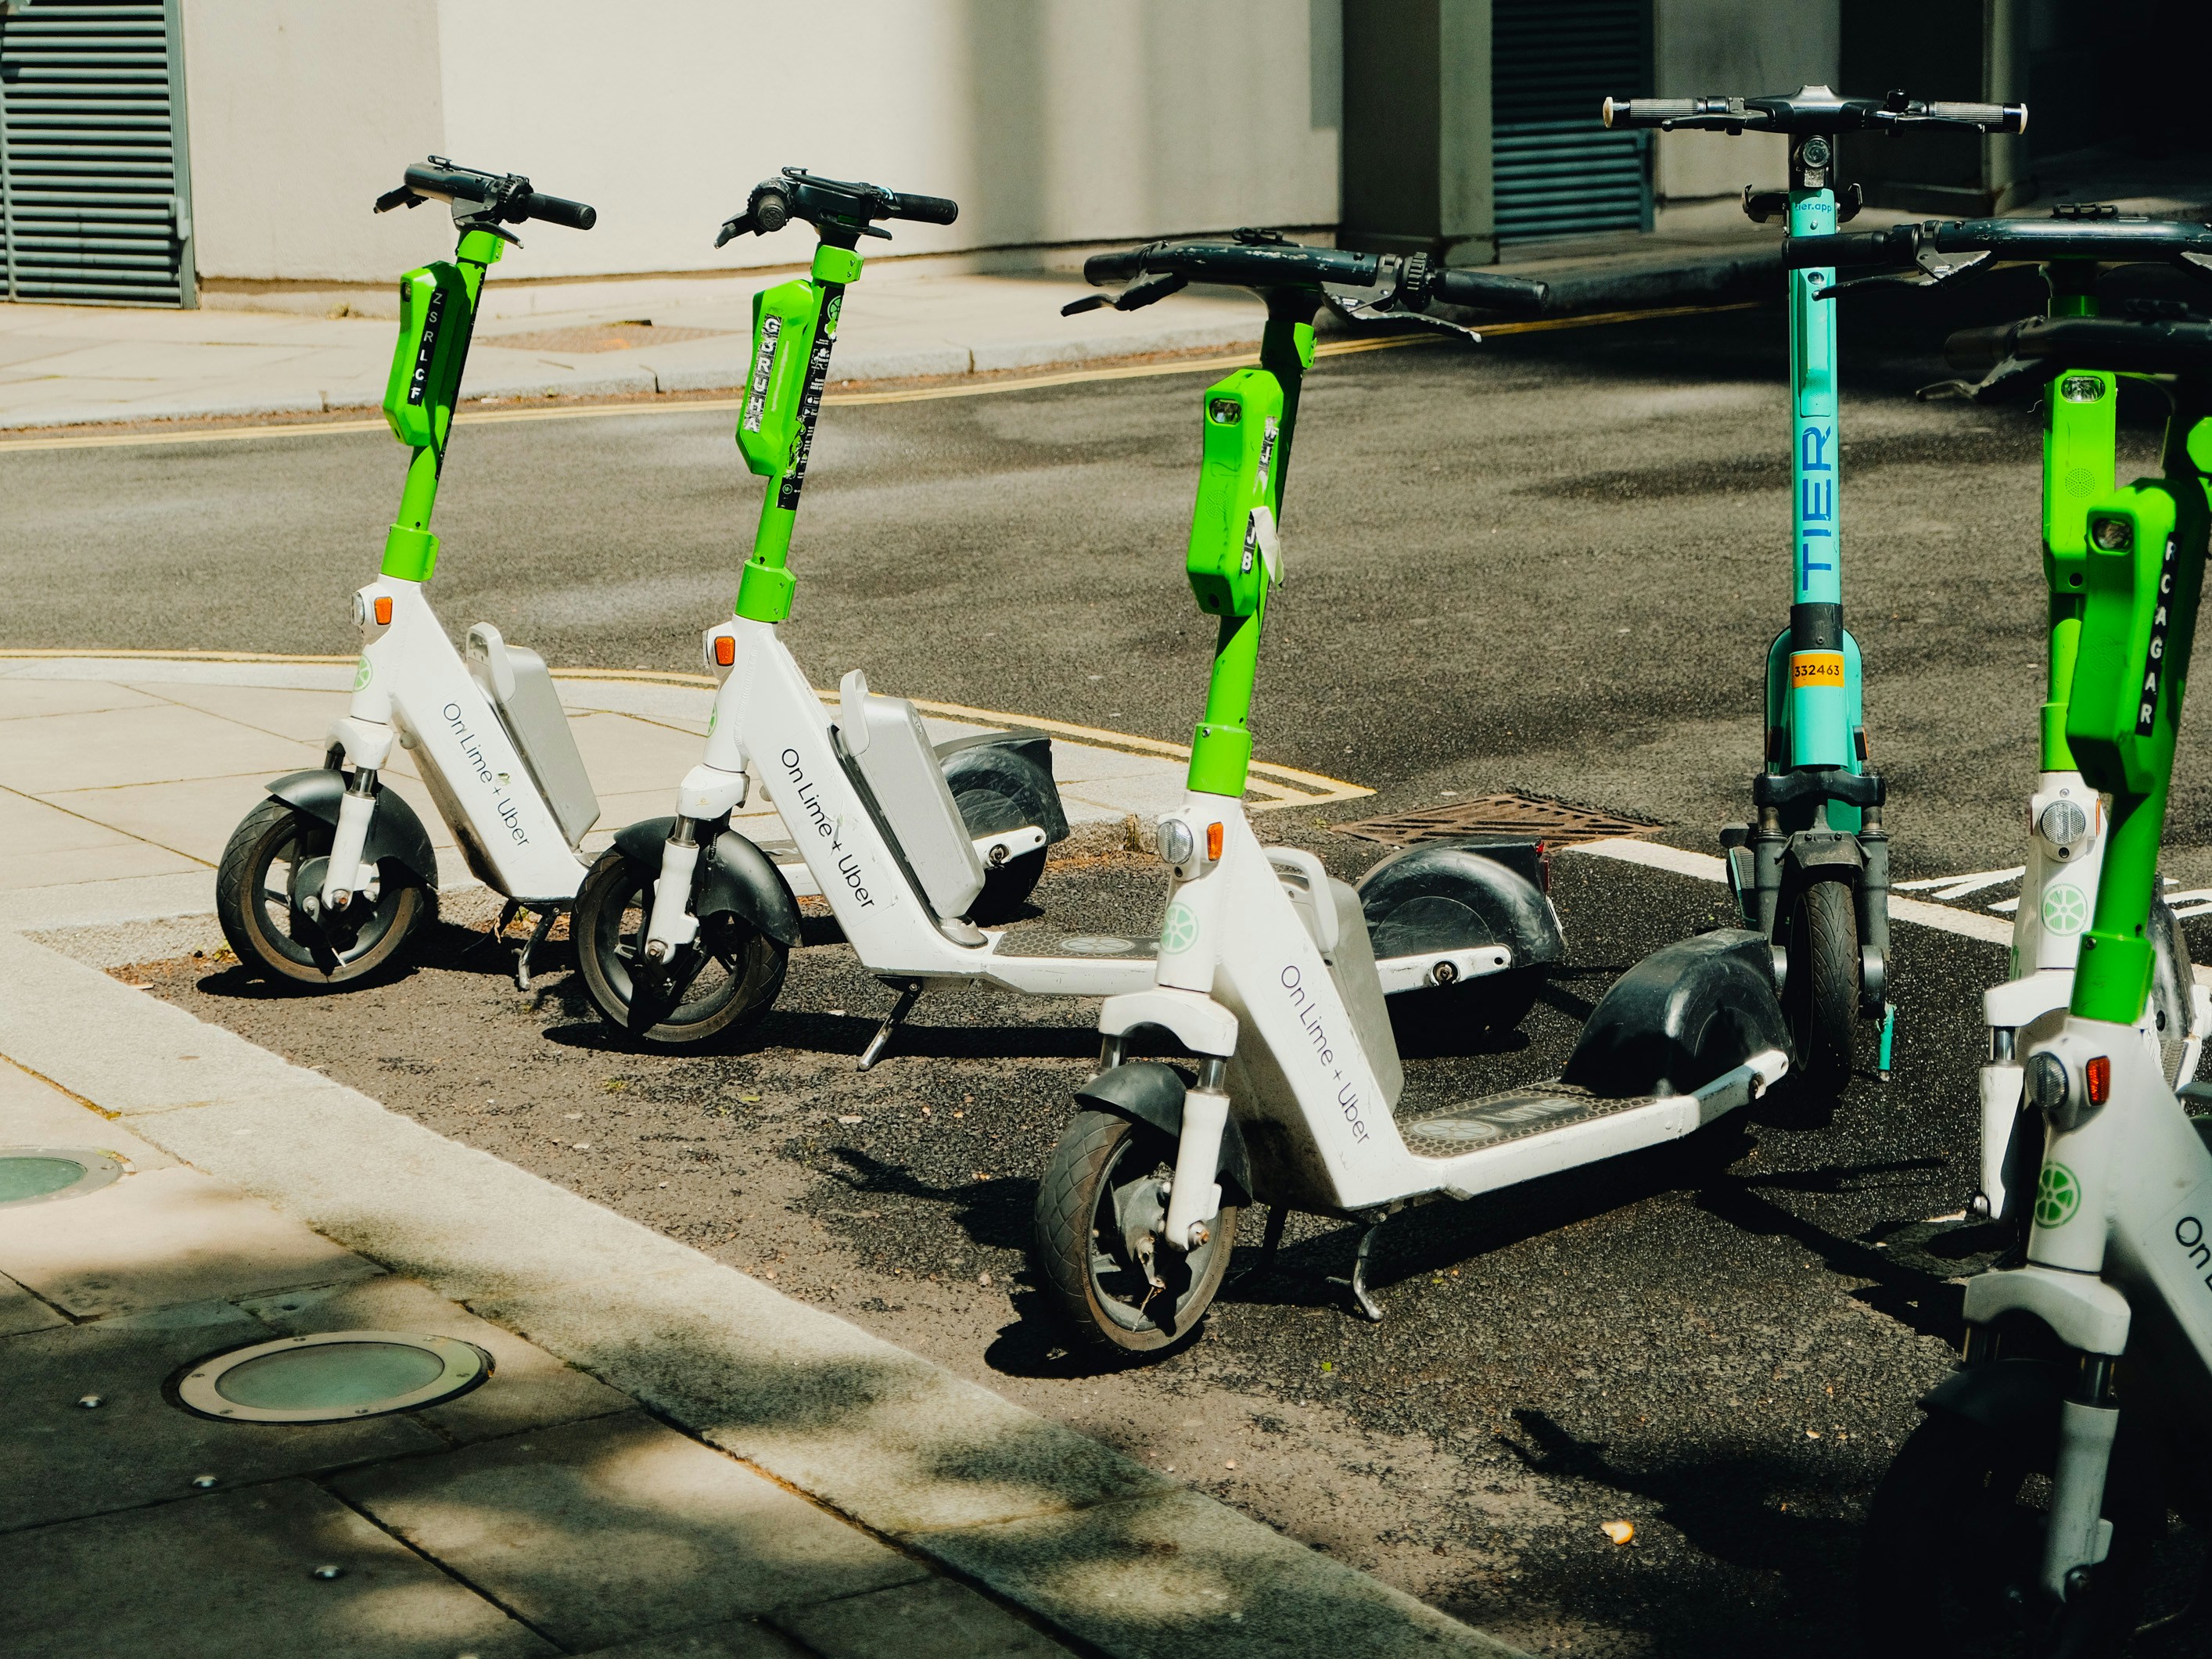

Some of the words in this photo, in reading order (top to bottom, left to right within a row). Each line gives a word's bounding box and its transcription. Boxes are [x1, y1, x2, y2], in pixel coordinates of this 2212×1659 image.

[411, 293, 443, 399] ZSRLCF
[1802, 426, 1832, 591] TIER
[1794, 665, 1840, 677] 332463
[443, 703, 466, 735] On
[460, 734, 493, 784] Lime
[497, 798, 530, 846] Uber
[781, 749, 804, 783] On
[798, 782, 832, 838] Lime
[838, 853, 874, 907] Uber
[1281, 965, 1305, 1007] On
[1300, 1003, 1334, 1067] Lime
[1338, 1082, 1370, 1144] Uber
[2175, 1216, 2211, 1269] On
